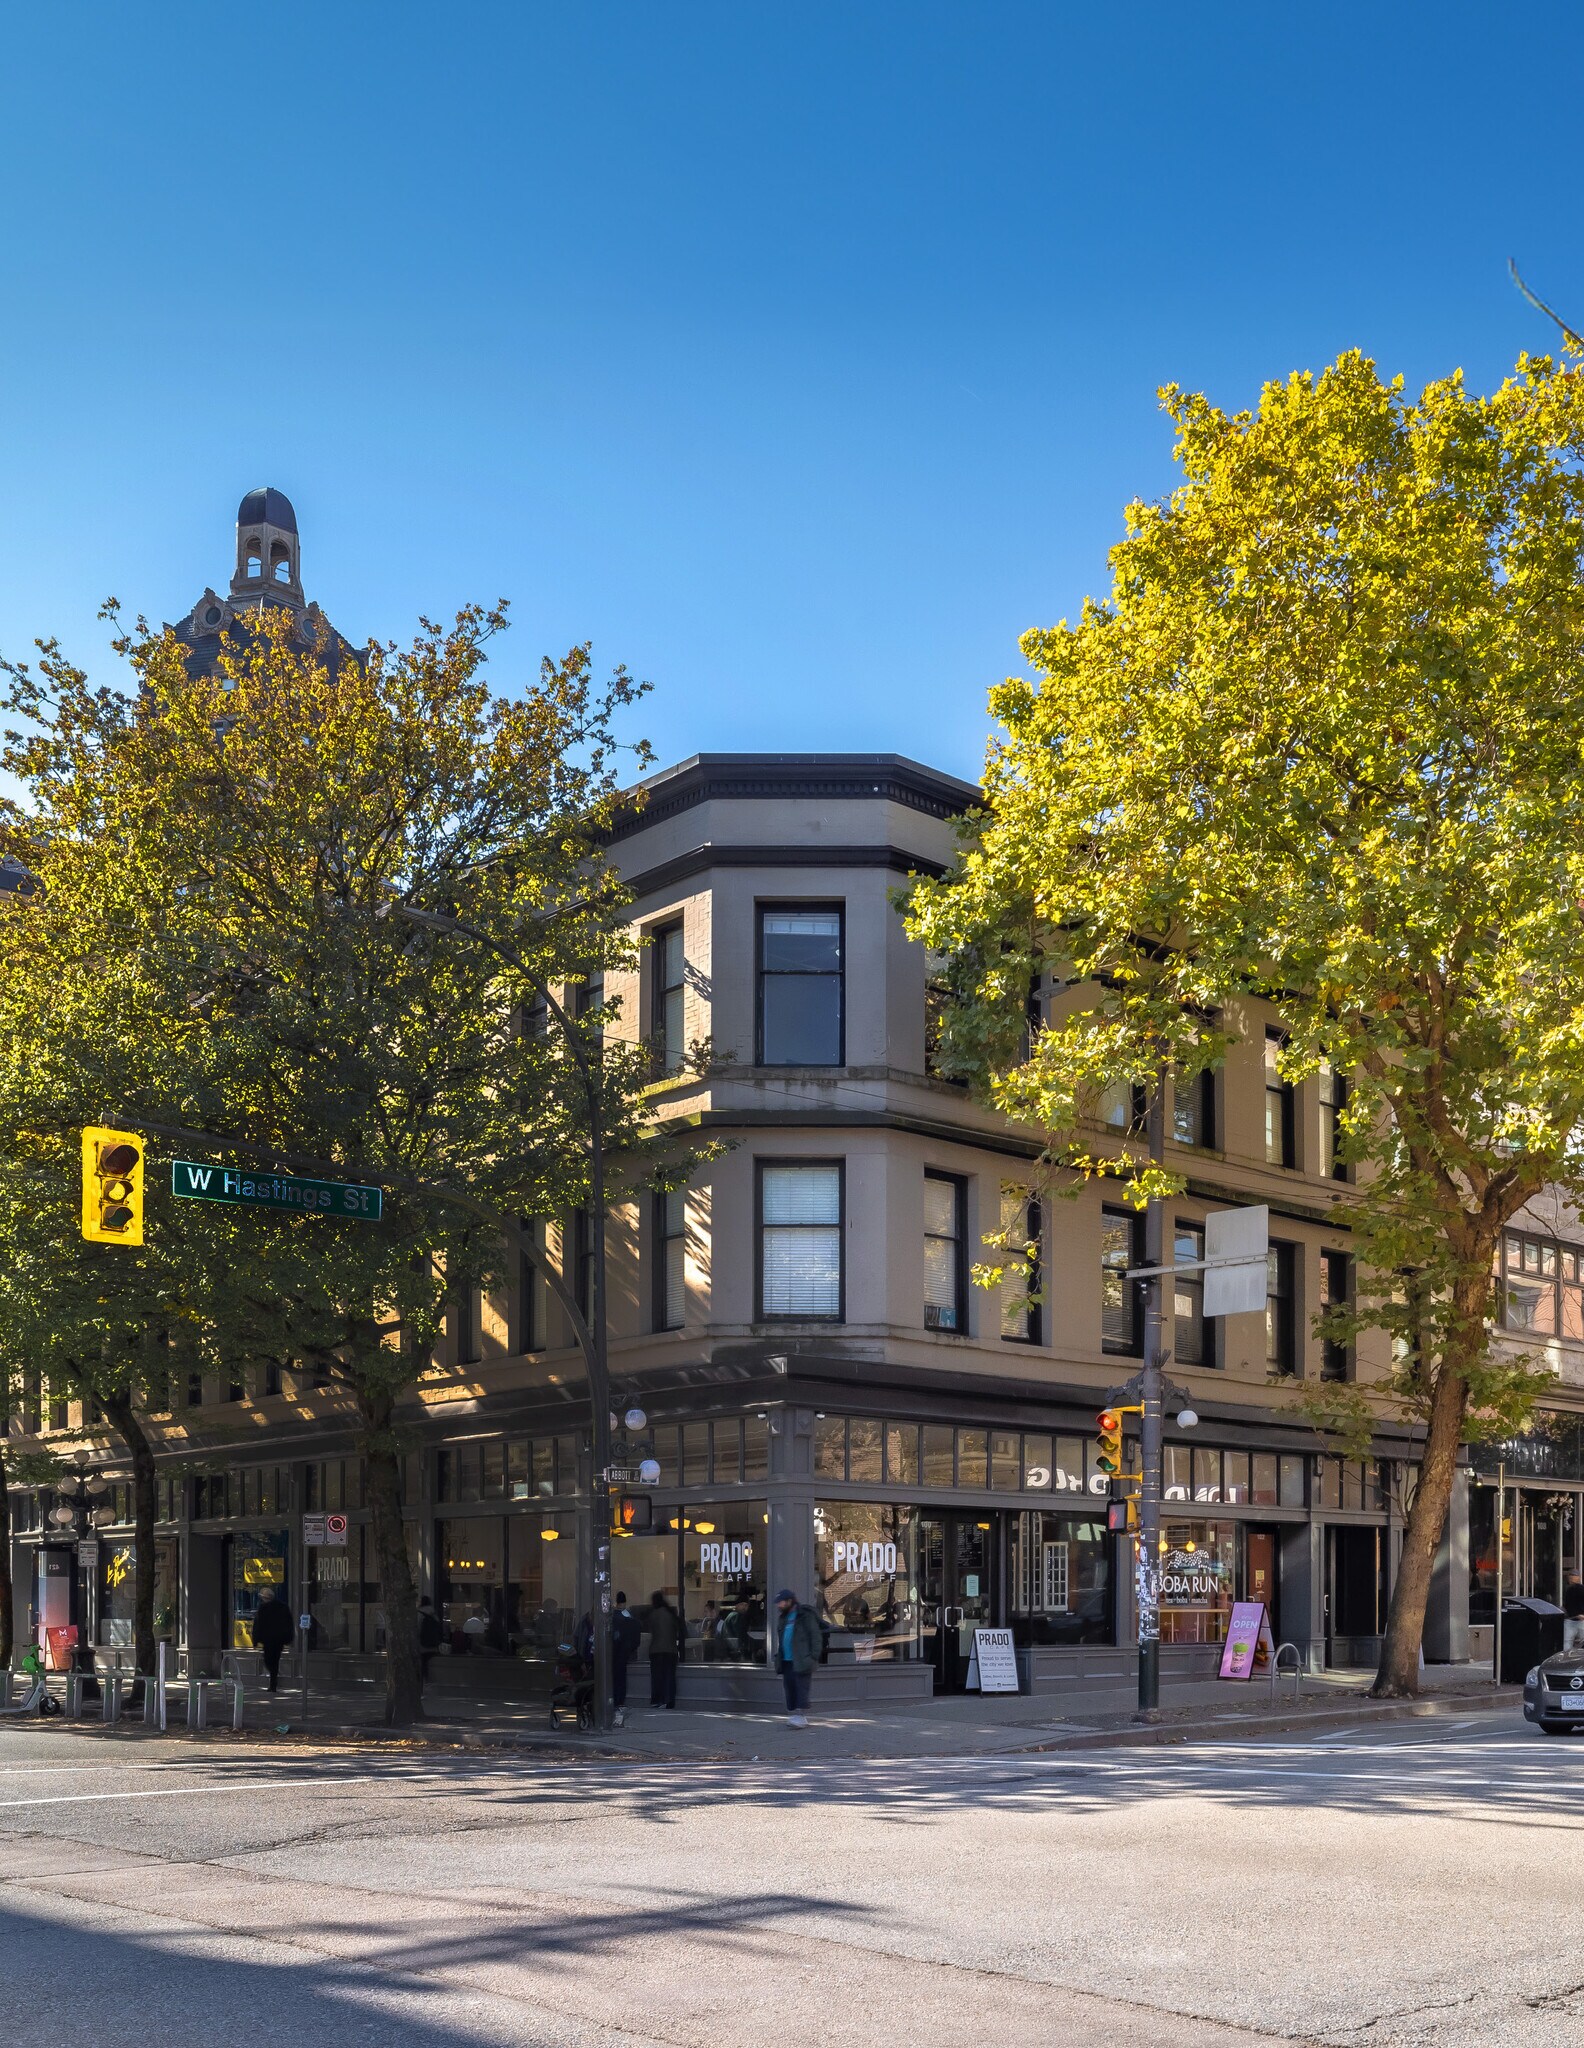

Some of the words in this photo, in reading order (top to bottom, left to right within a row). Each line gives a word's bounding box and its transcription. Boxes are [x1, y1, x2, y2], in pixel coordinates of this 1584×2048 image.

[187, 1167, 212, 1190] W
[224, 1172, 331, 1208] Hastings
[344, 1189, 369, 1211] St
[611, 1470, 631, 1480] ABBOTT
[701, 1541, 752, 1573] PRADO
[834, 1541, 897, 1573] PRADO
[318, 1556, 349, 1581] PRADO
[1193, 1576, 1218, 1593] RUN
[1233, 1620, 1258, 1629] OPEN
[979, 1633, 1009, 1646] PRADO
